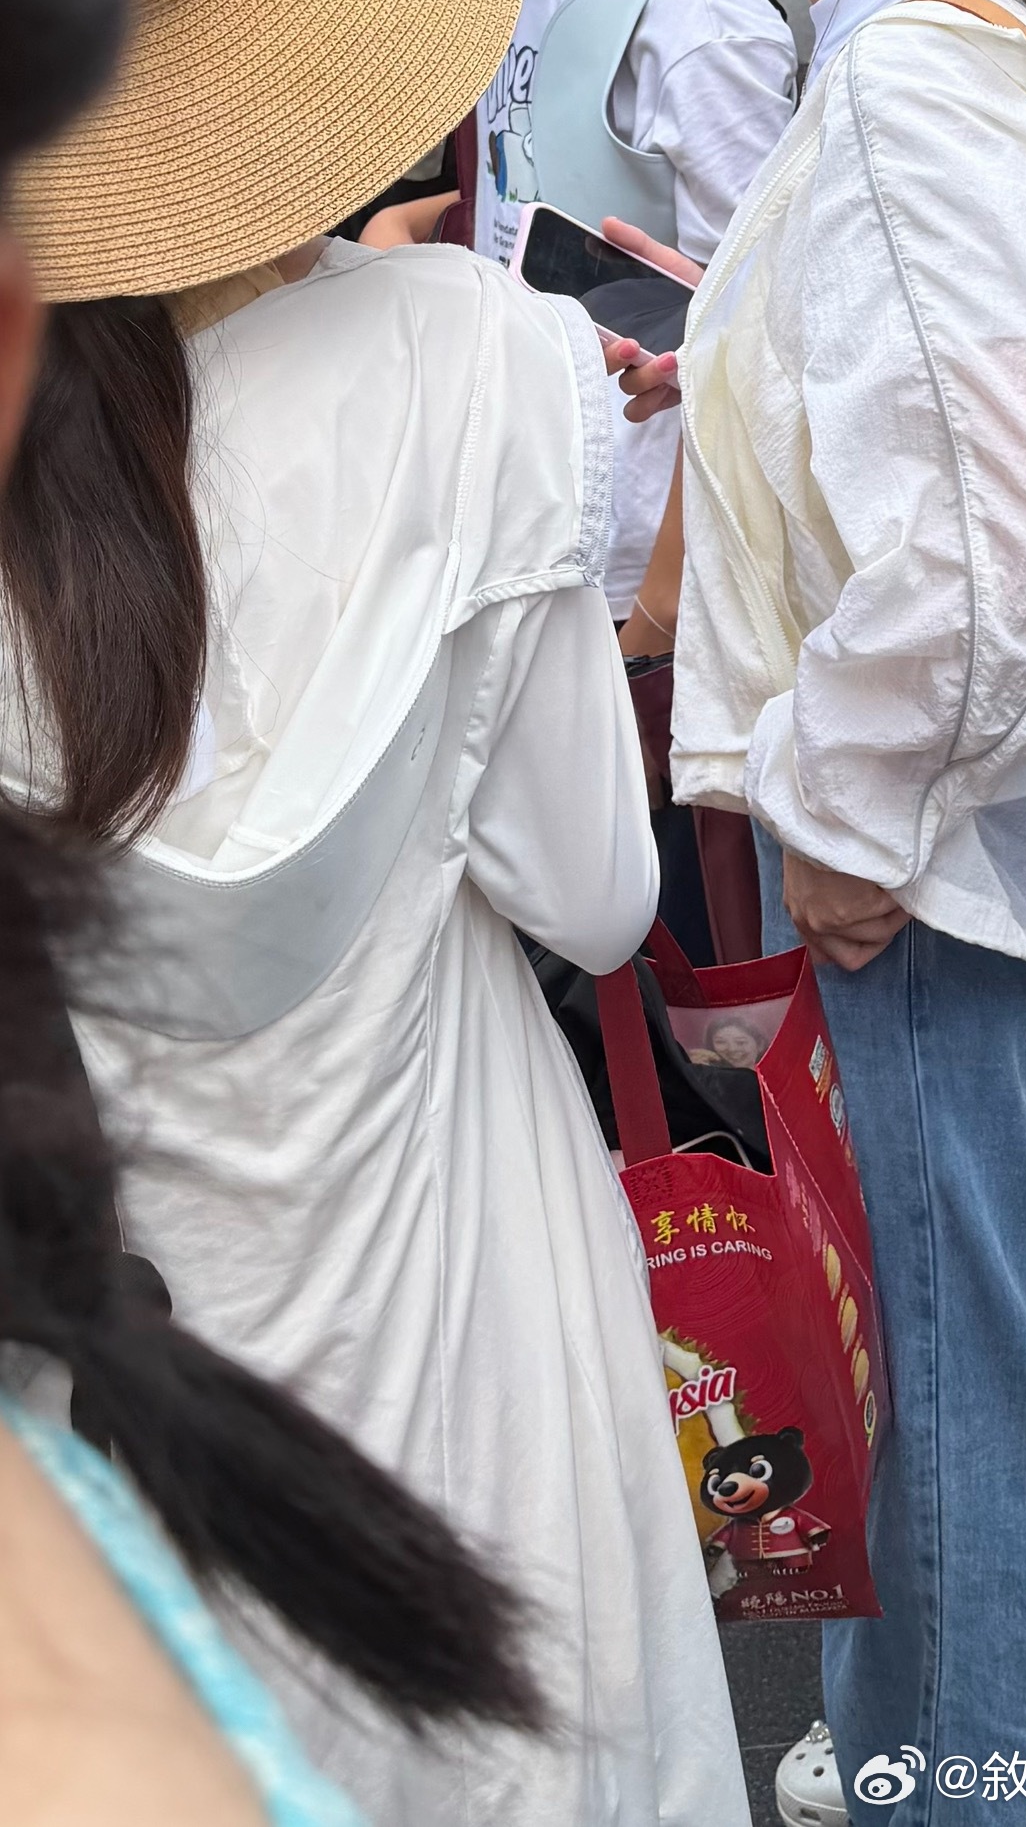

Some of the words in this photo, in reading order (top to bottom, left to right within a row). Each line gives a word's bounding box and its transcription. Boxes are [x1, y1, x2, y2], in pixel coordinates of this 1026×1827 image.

[690, 1243, 707, 1259] IS
[711, 1239, 773, 1261] CARING
[791, 1583, 844, 1603] NO.1
